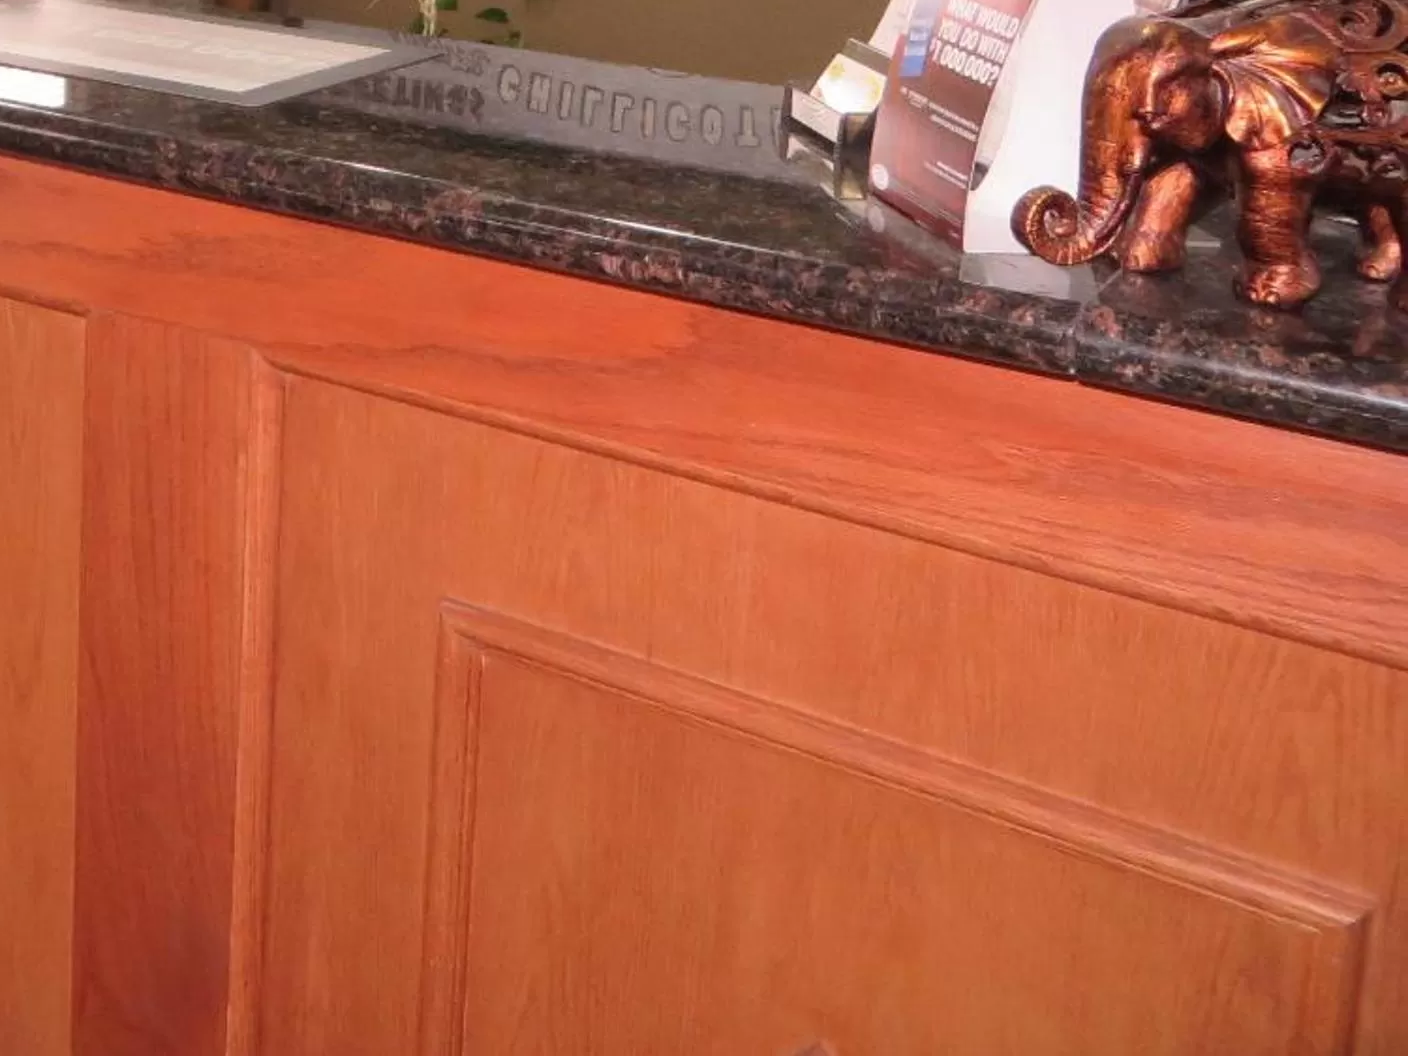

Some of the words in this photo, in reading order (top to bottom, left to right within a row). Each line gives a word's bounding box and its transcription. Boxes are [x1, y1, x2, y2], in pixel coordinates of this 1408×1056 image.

[976, 5, 1020, 39] WOULD
[938, 20, 961, 41] YOU
[958, 25, 980, 52] DO
[976, 32, 1011, 63] WITH
